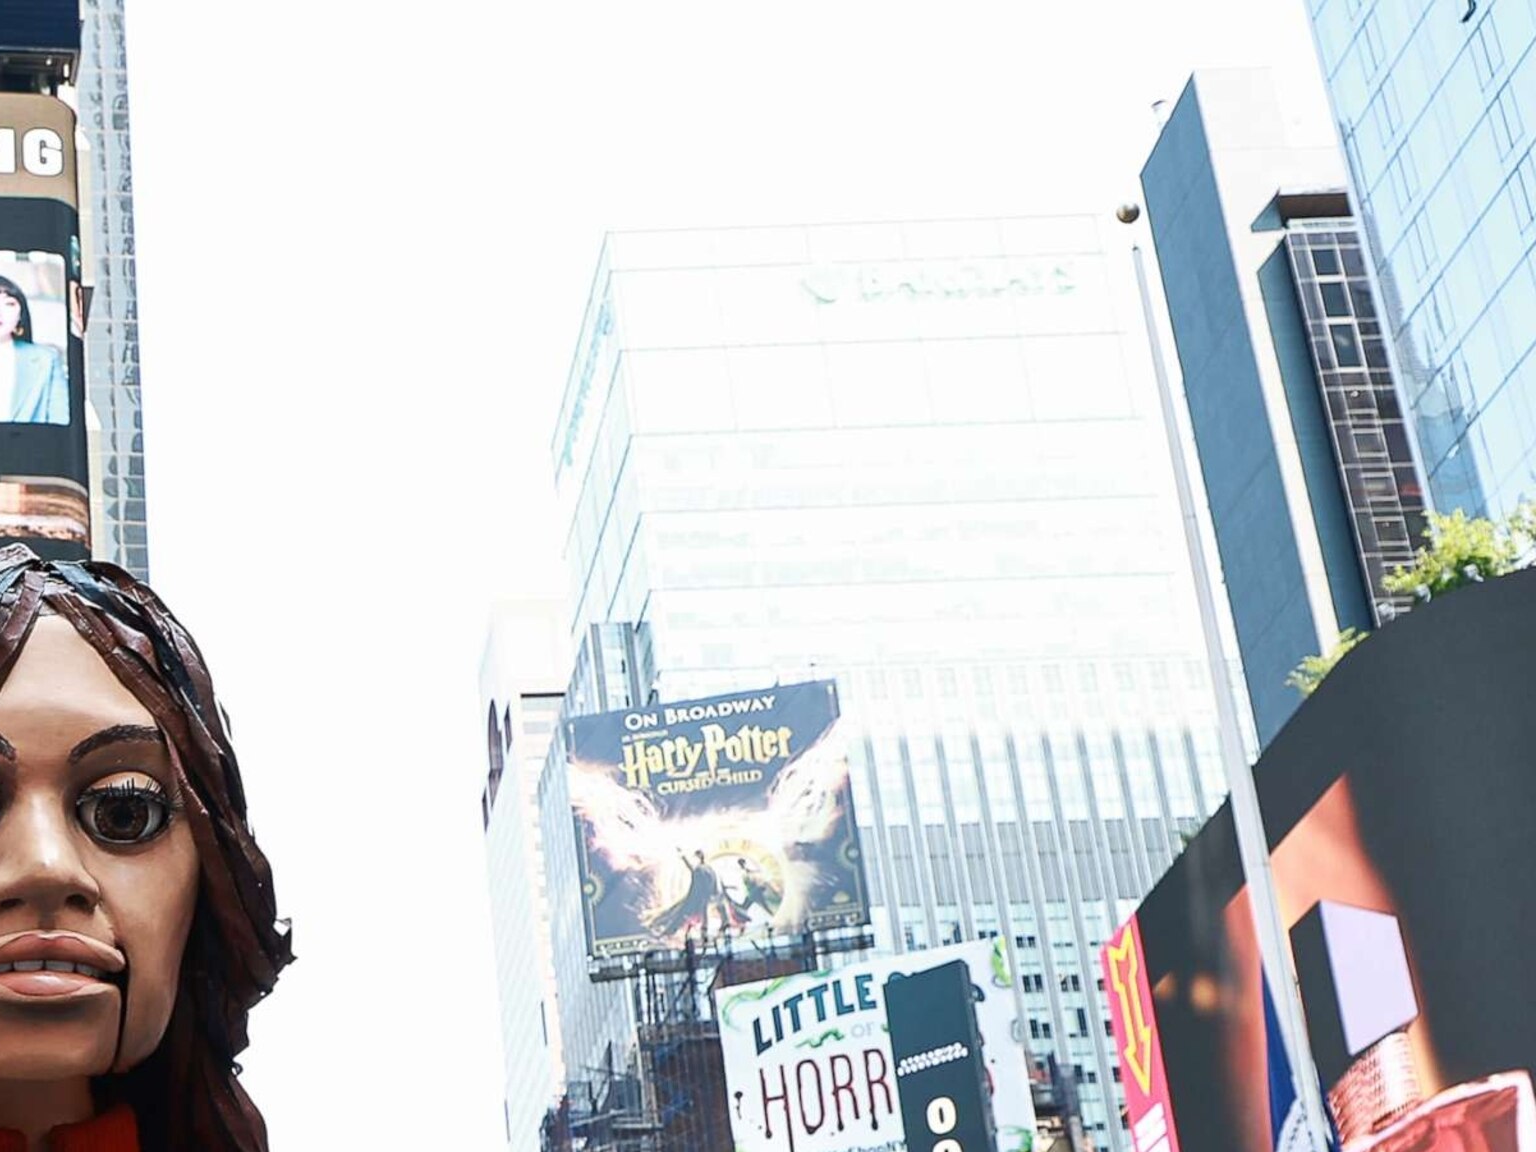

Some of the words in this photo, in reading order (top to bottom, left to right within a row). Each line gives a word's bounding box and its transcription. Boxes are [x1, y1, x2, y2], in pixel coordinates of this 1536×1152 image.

[625, 713, 658, 730] ON
[665, 695, 775, 725] BROADWAY
[618, 739, 704, 788] Harry
[700, 723, 792, 780] Potter
[657, 774, 714, 796] CURSED
[717, 770, 763, 787] CHILD
[752, 973, 878, 1057] LITTLE
